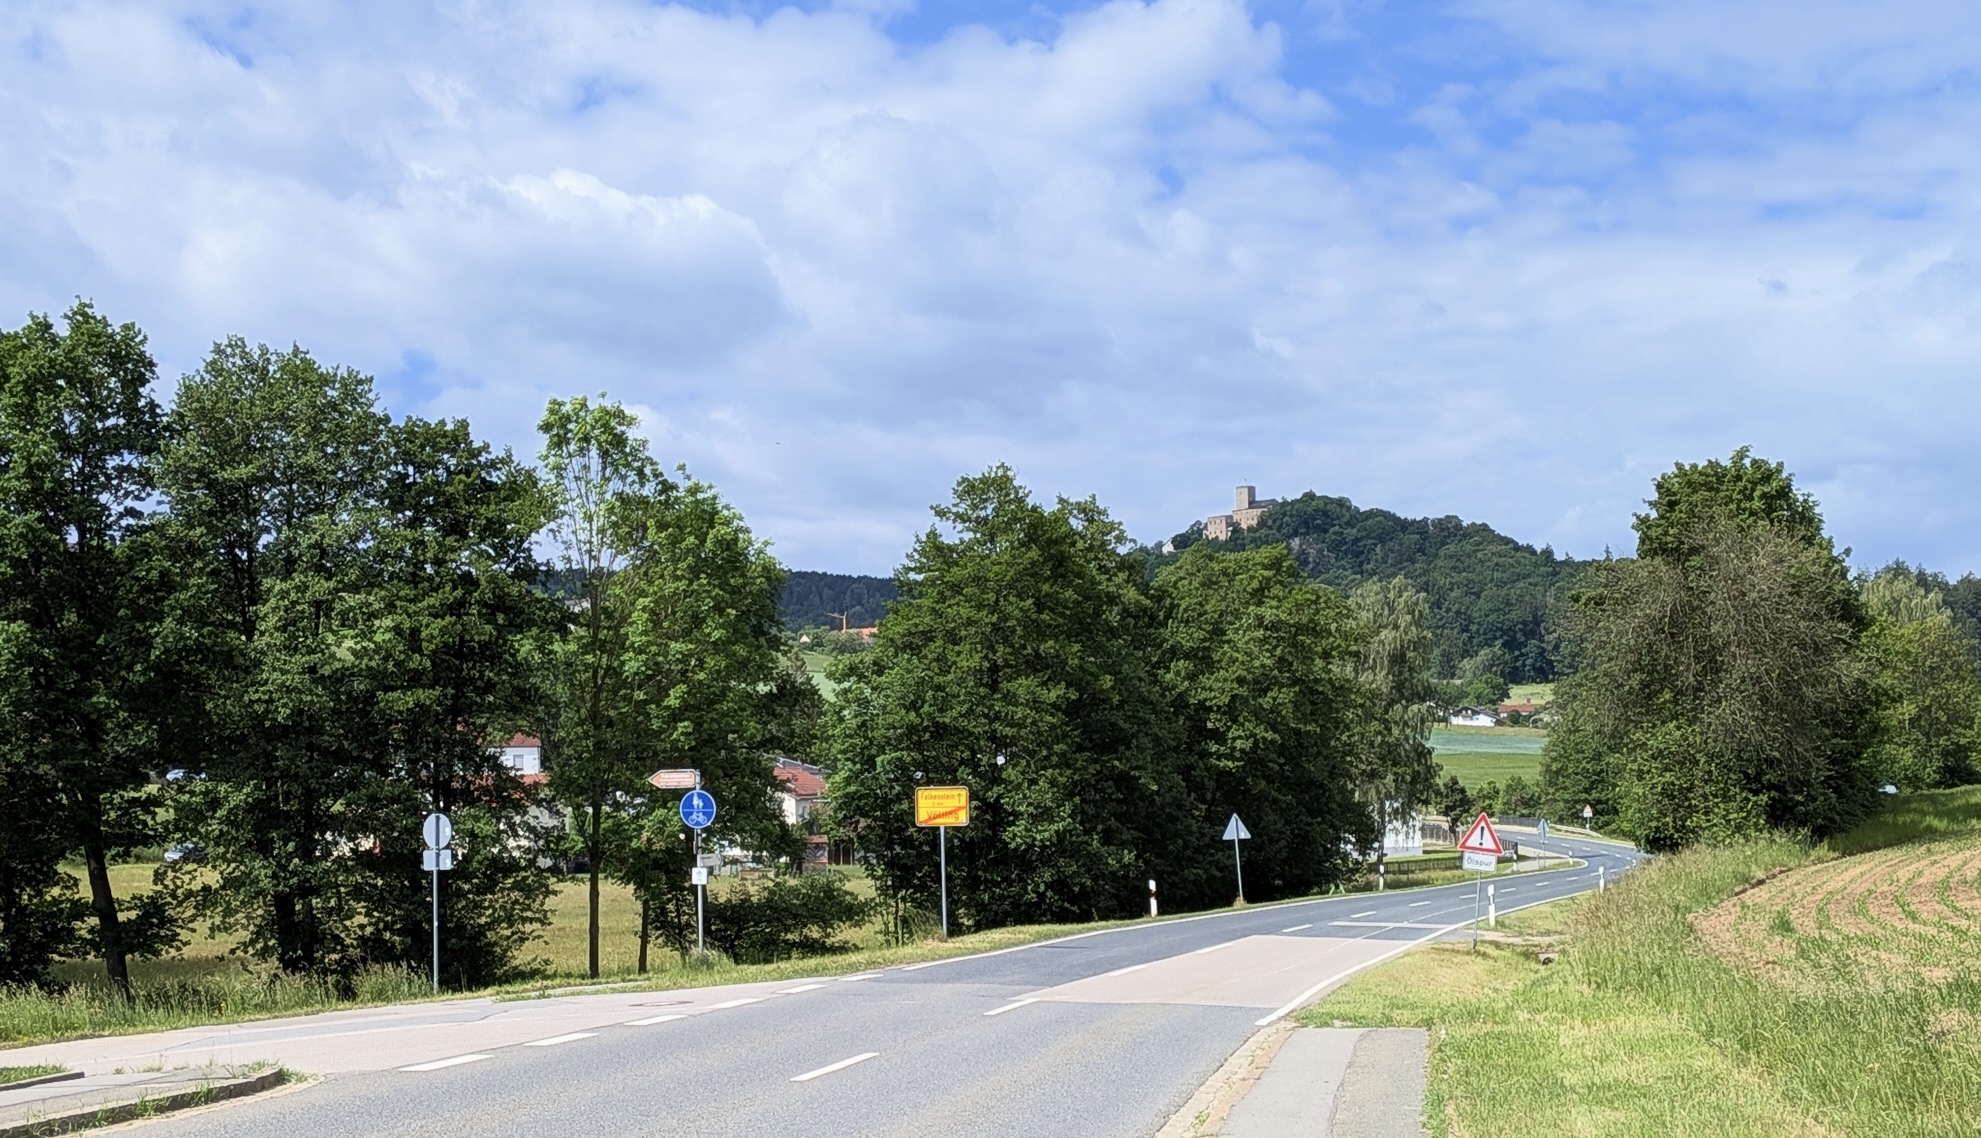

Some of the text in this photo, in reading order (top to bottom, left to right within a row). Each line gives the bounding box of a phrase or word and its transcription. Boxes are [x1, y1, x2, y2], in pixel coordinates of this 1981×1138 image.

[920, 791, 956, 801] Falkenstein
[926, 810, 960, 822] Völling
[1466, 856, 1493, 868] Ölspur
